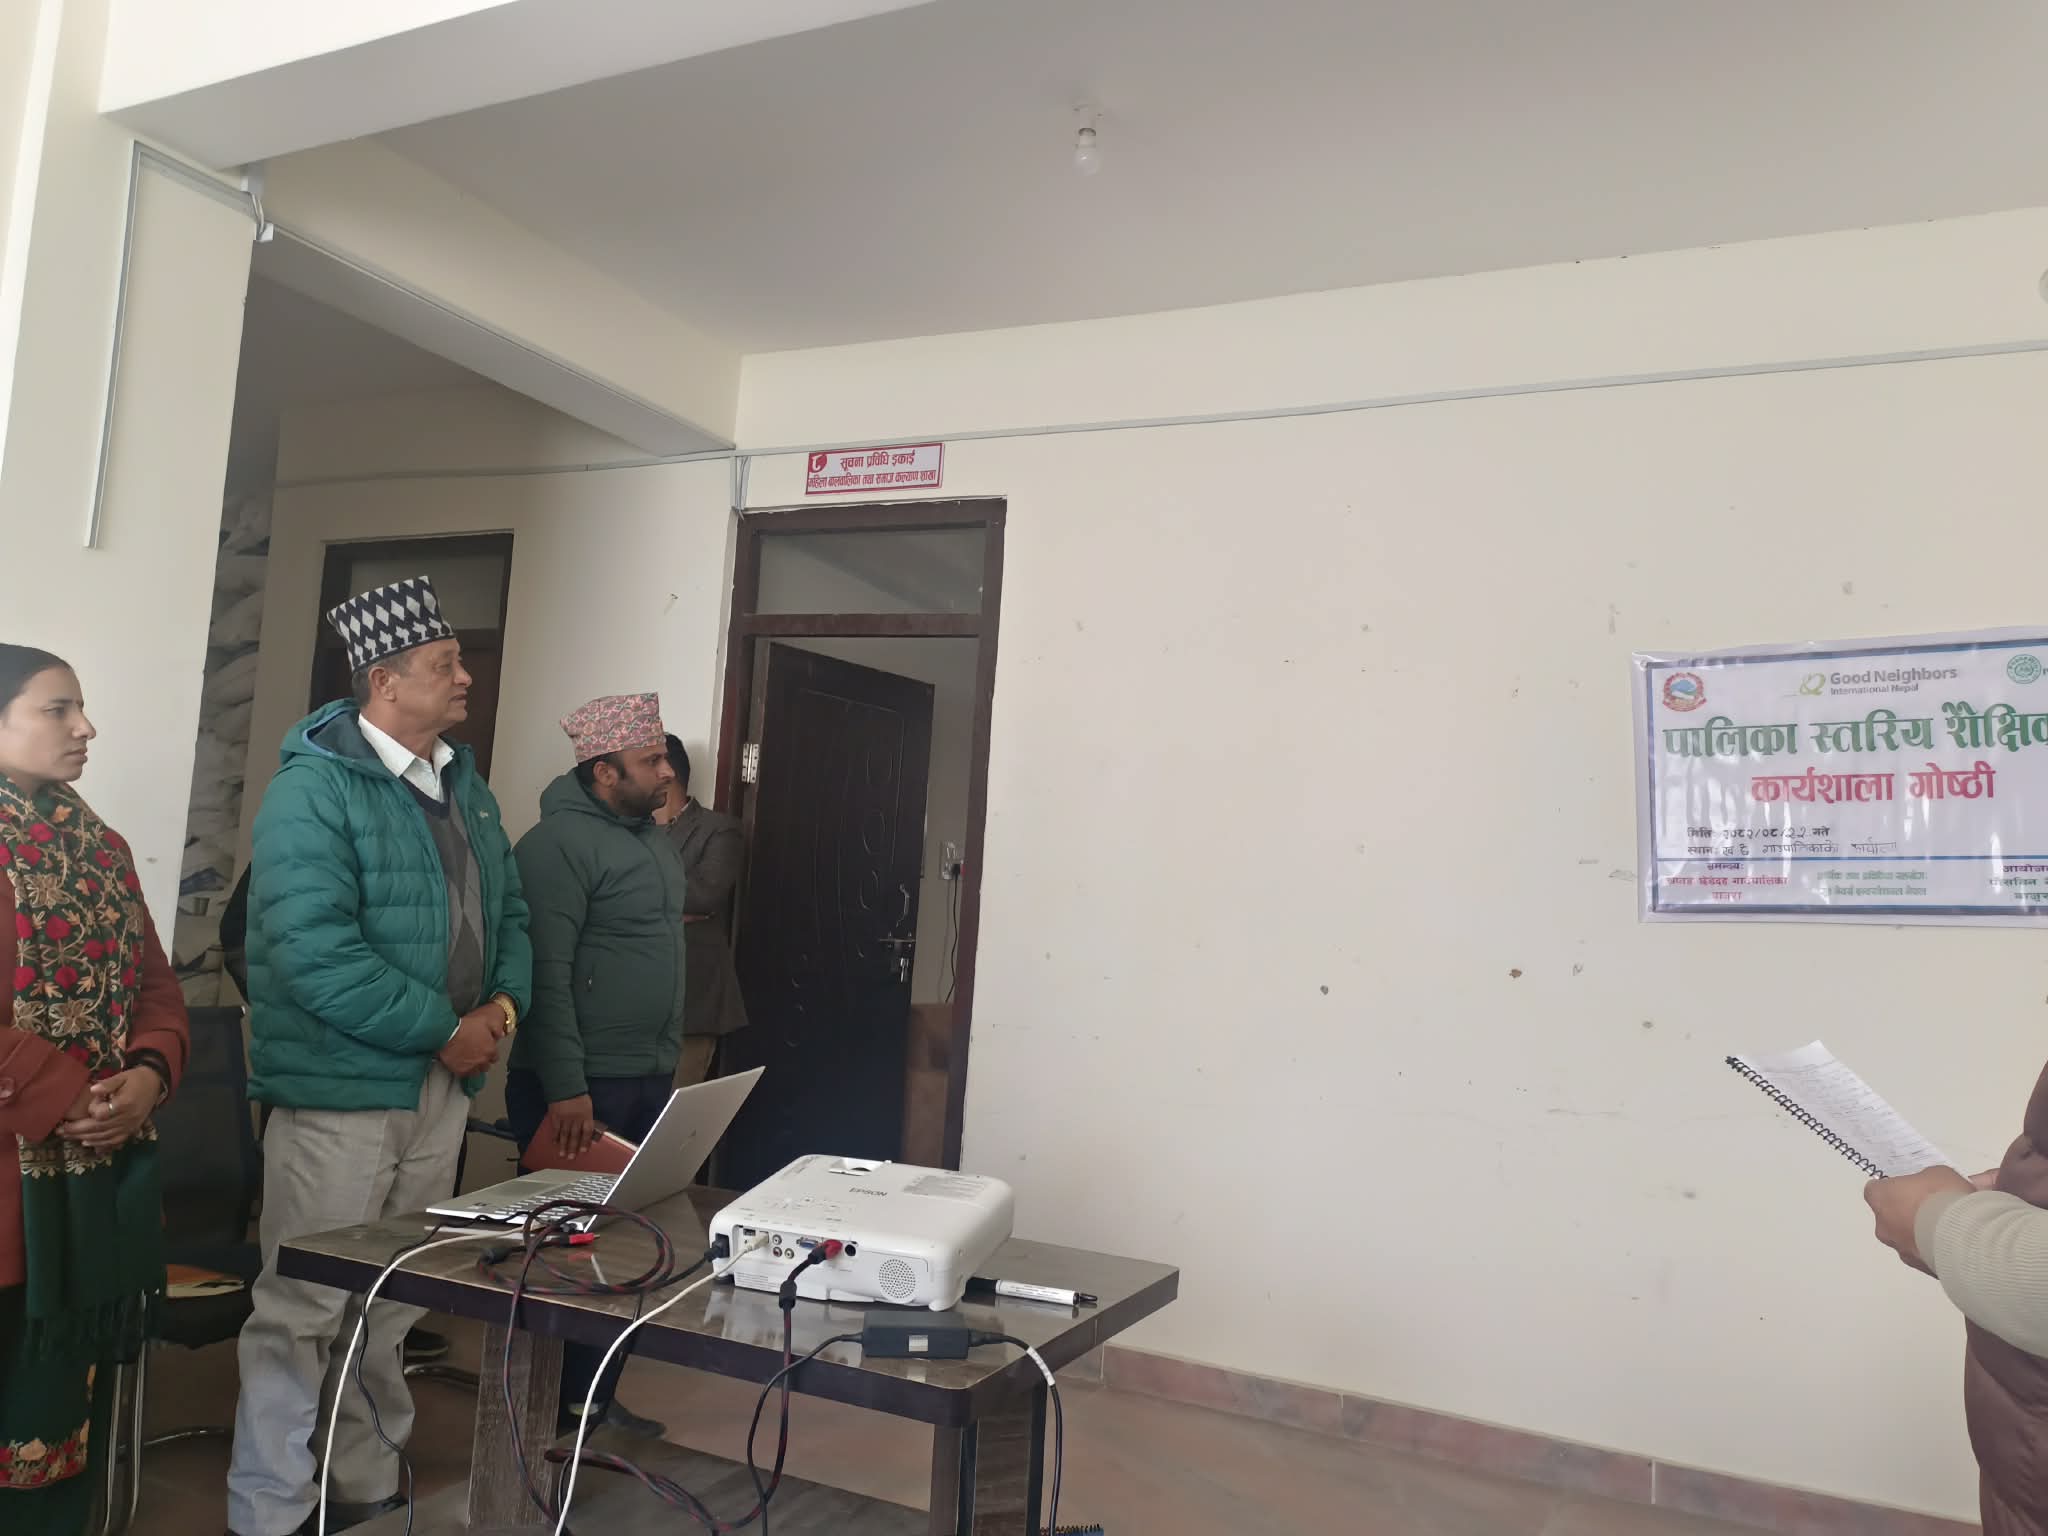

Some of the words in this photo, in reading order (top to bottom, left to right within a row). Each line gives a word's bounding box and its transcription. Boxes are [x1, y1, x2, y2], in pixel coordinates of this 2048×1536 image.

[840, 456, 864, 471] सूचना
[867, 451, 889, 467] प्रविधि
[892, 449, 915, 466] इकाई
[1830, 671, 1871, 685] Good
[1874, 667, 1958, 684] Neighbors
[1830, 686, 1889, 696] International
[1891, 683, 1919, 694] Nepal
[1662, 716, 1798, 757] पालिका
[1808, 709, 1934, 753] स्तरिय
[1751, 766, 1895, 803] कार्यशाला
[1908, 760, 1996, 799] गोष्ठी
[849, 1187, 888, 1197] EPSON
